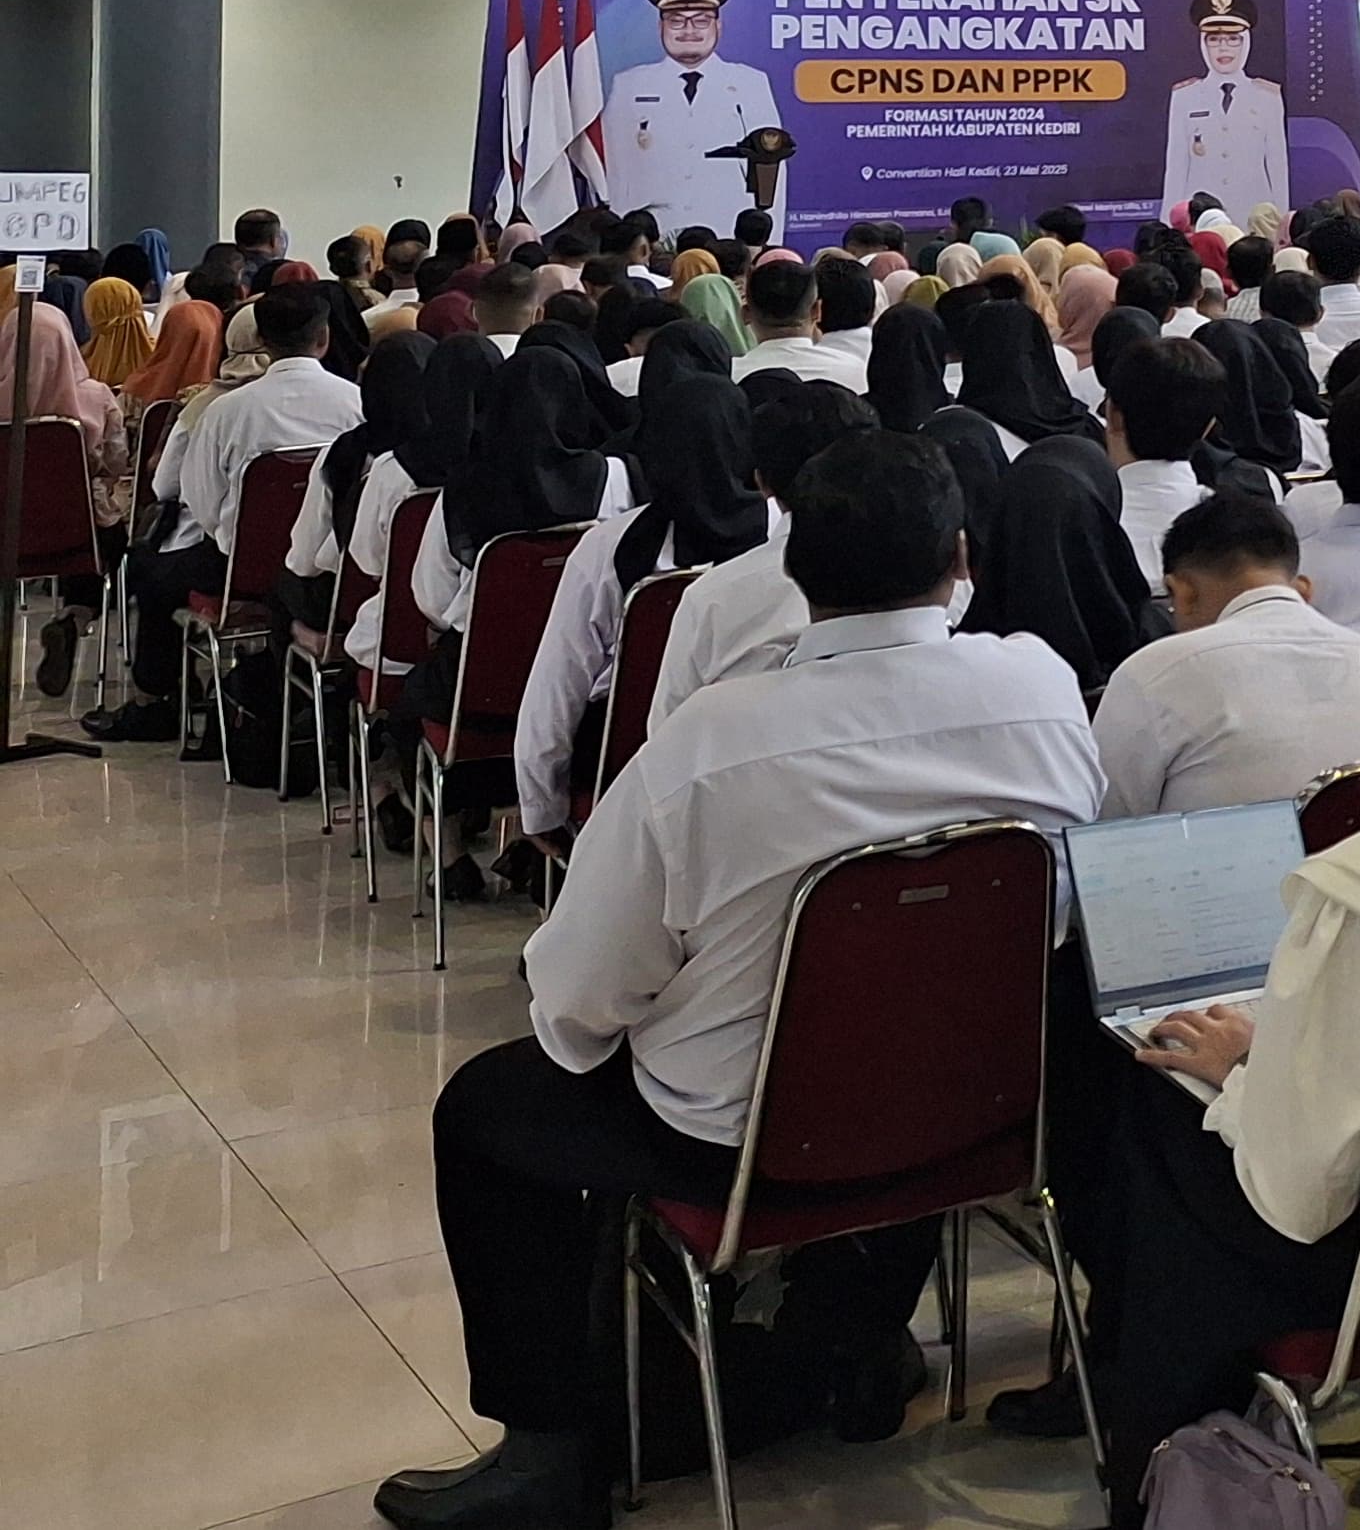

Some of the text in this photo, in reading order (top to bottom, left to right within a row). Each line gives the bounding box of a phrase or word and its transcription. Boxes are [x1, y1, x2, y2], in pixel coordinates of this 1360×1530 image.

[771, 14, 1145, 50] PENGANGKATAN
[830, 68, 1094, 94] CPNS DAN PPPK
[884, 108, 1045, 123] FORMASI TAHUN 2024
[846, 122, 1081, 138] PEMERINTAH KABUPATEN KEDIRI
[876, 168, 942, 180] Convention
[1003, 166, 1018, 176] 23
[1040, 165, 1069, 176] 2025
